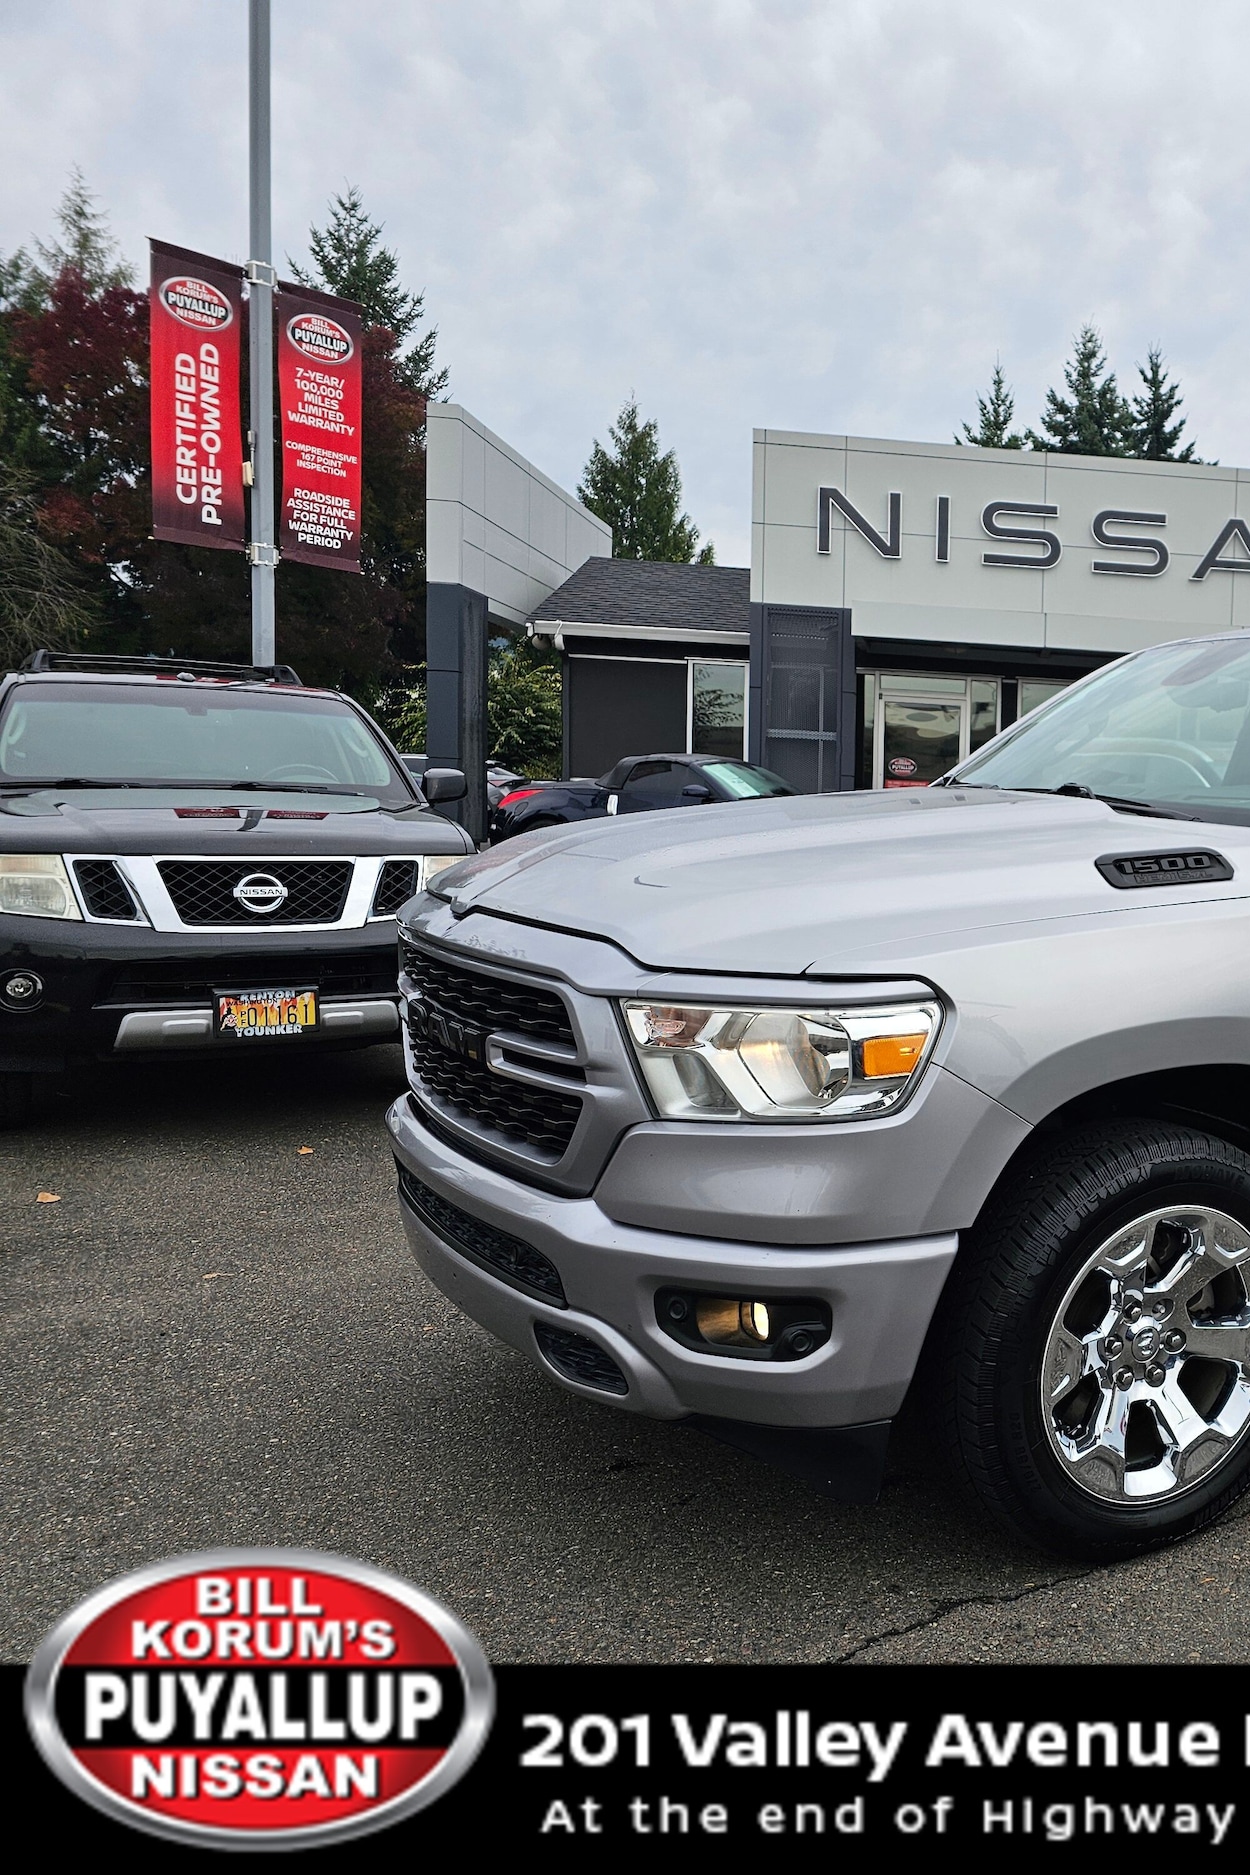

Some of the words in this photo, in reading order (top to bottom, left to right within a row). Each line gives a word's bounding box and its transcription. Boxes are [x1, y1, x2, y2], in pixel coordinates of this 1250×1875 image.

[186, 280, 208, 293] BILL
[168, 291, 226, 319] PUYALLUP
[176, 307, 216, 326] NISSAN
[311, 317, 330, 329] BILL
[294, 328, 348, 353] PUYALLUP
[301, 342, 339, 360] NISSAN
[294, 378, 344, 400] 100,000
[295, 366, 345, 390] 7-YEAR/
[297, 401, 345, 423] LIMITED
[304, 391, 340, 411] MILES
[175, 353, 198, 505] CERTIFIED
[200, 342, 222, 526] PRE-OWNED
[287, 410, 355, 437] WARRANTY
[285, 440, 358, 465] COMPREHENSIVE
[300, 451, 316, 462] 167
[316, 455, 343, 469] POINT
[296, 459, 347, 478] INSPECTION
[286, 497, 356, 521] ASSISTANCE
[293, 487, 351, 509] ROADSIDE
[288, 519, 354, 541] WARRANTY
[293, 509, 318, 524] FOR
[319, 514, 347, 530] FULL
[297, 531, 342, 549] PERIOD
[1119, 855, 1211, 874] 1500
[240, 990, 296, 1001] KENTON
[247, 1004, 309, 1027] 01161
[234, 1024, 303, 1038] YOUNKER
